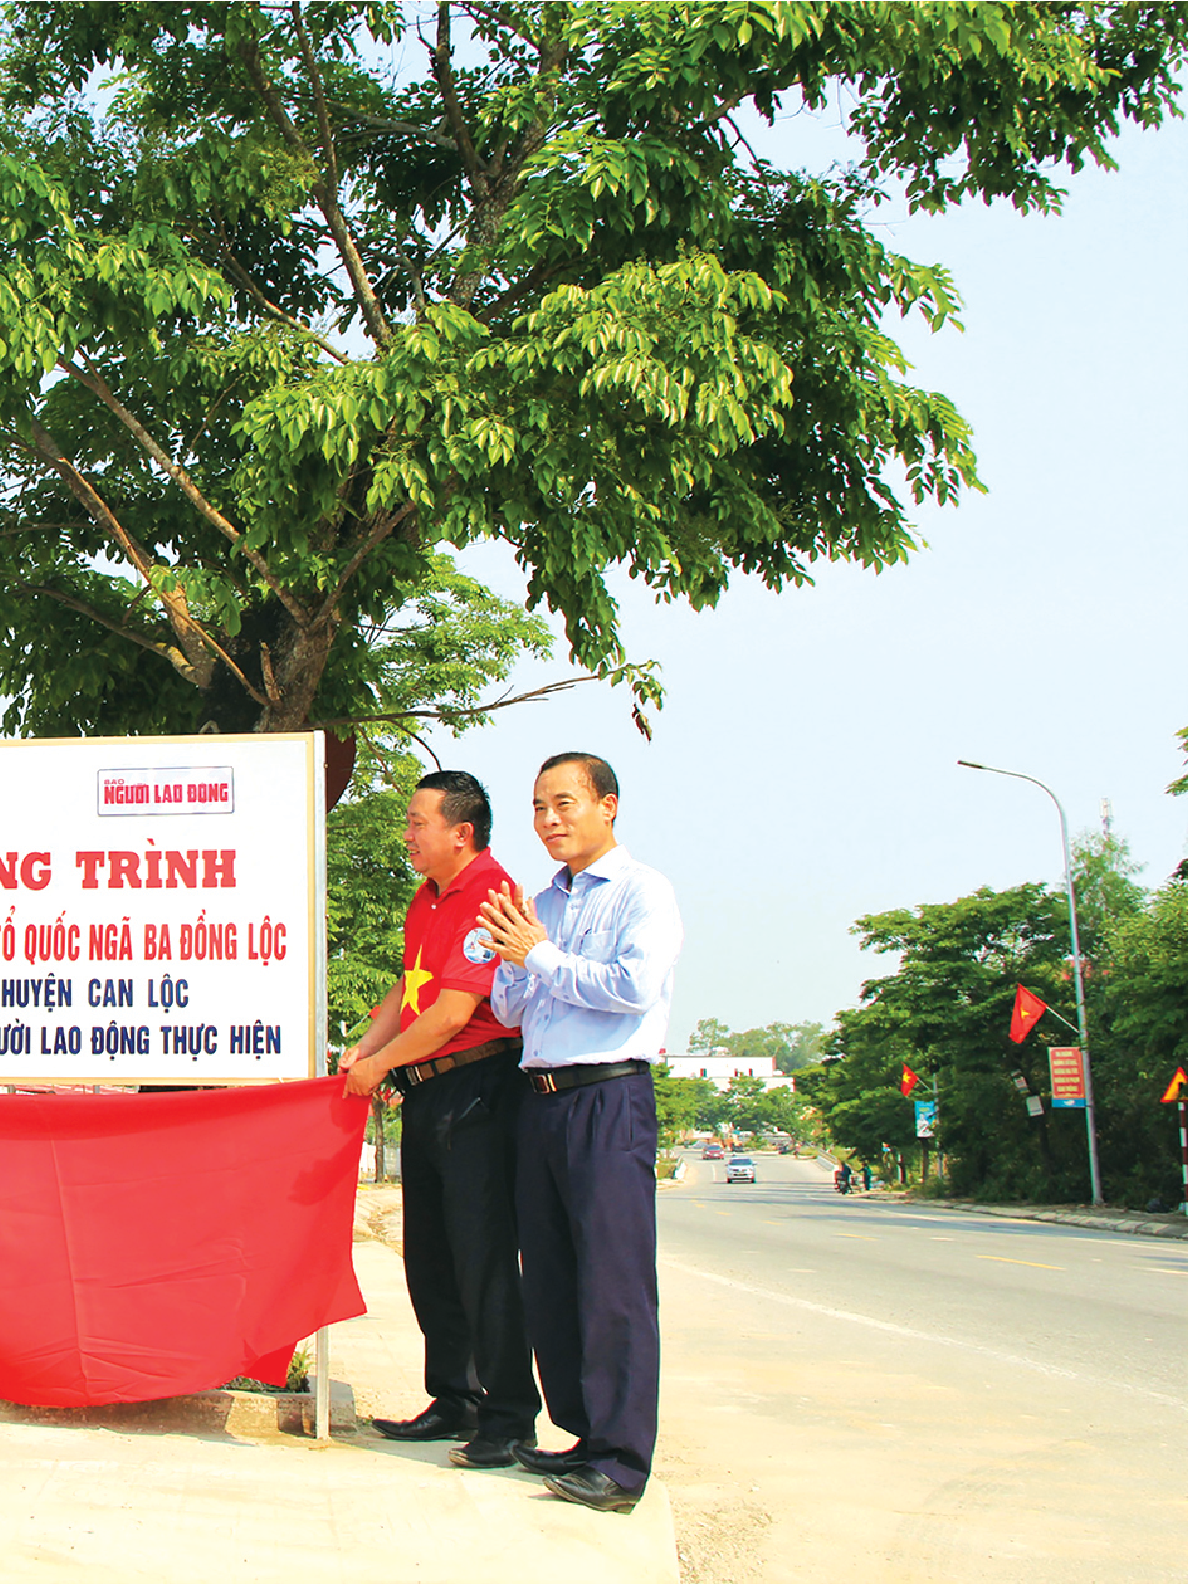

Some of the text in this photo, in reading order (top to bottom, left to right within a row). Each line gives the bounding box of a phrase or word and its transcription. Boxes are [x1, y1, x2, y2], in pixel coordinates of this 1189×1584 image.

[154, 784, 182, 803] LAO
[75, 838, 236, 889] TRÌNH
[24, 910, 81, 965] QUỐC
[89, 916, 133, 961] NGÃ
[144, 924, 172, 961] BA
[180, 909, 237, 961] ĐỒNG
[248, 915, 286, 966] LỘC
[1, 972, 71, 1013] HUYỆN
[88, 978, 133, 1008] CAN
[148, 973, 189, 1014] LỘC
[41, 1026, 82, 1055] LAO
[90, 1020, 150, 1061] ĐỘNG
[159, 1023, 218, 1062] THỰC
[230, 1019, 282, 1060] HIỆN
